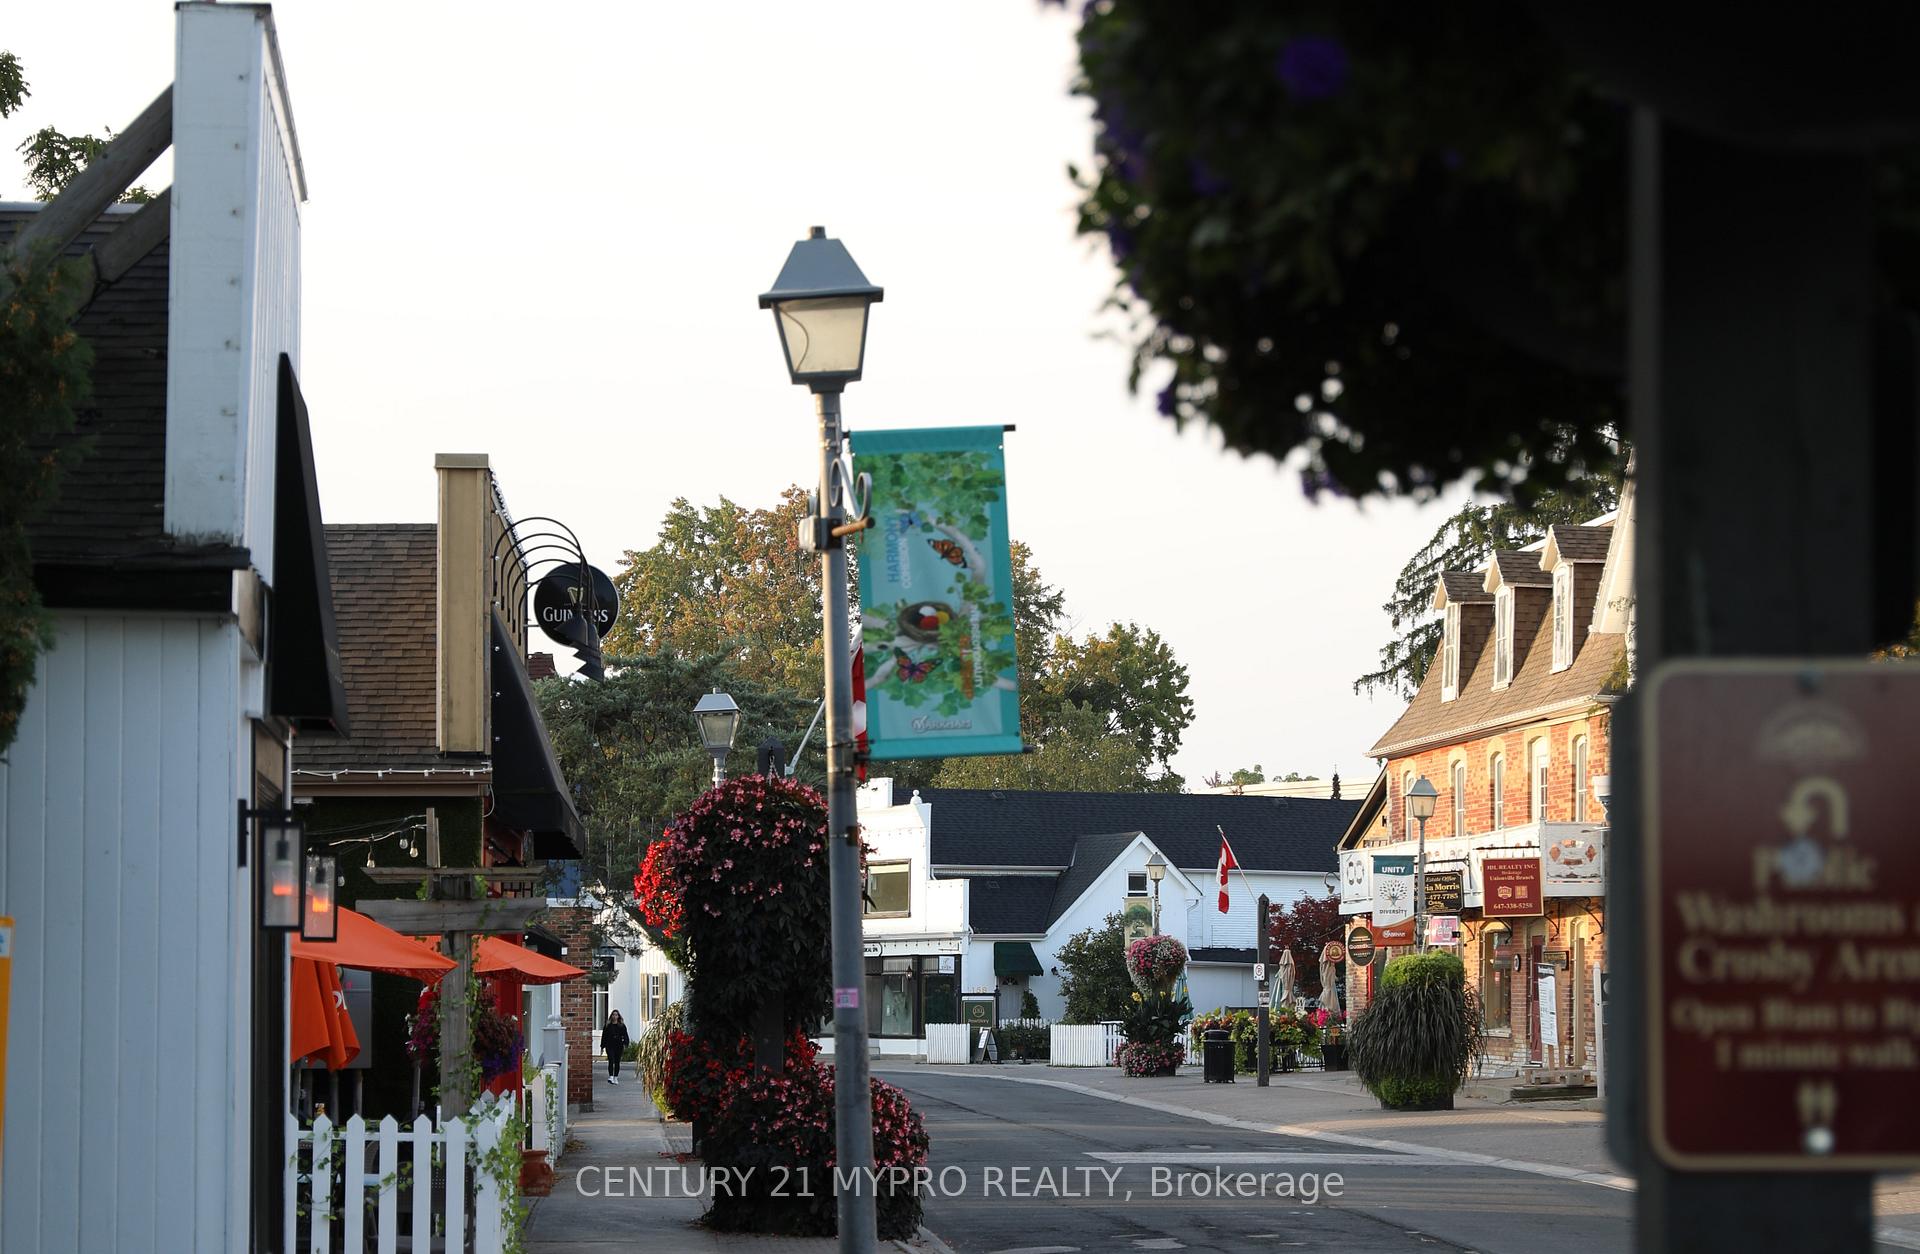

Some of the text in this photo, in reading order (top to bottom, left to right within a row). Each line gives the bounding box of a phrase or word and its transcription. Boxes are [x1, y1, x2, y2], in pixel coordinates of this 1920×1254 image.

[885, 514, 900, 584] HARMONY
[543, 607, 608, 622] GUISS
[1434, 883, 1460, 891] Morris
[1379, 908, 1407, 917] DIVERSITY
[1676, 891, 1906, 936] Washrooms
[1678, 939, 1819, 993] Crosby
